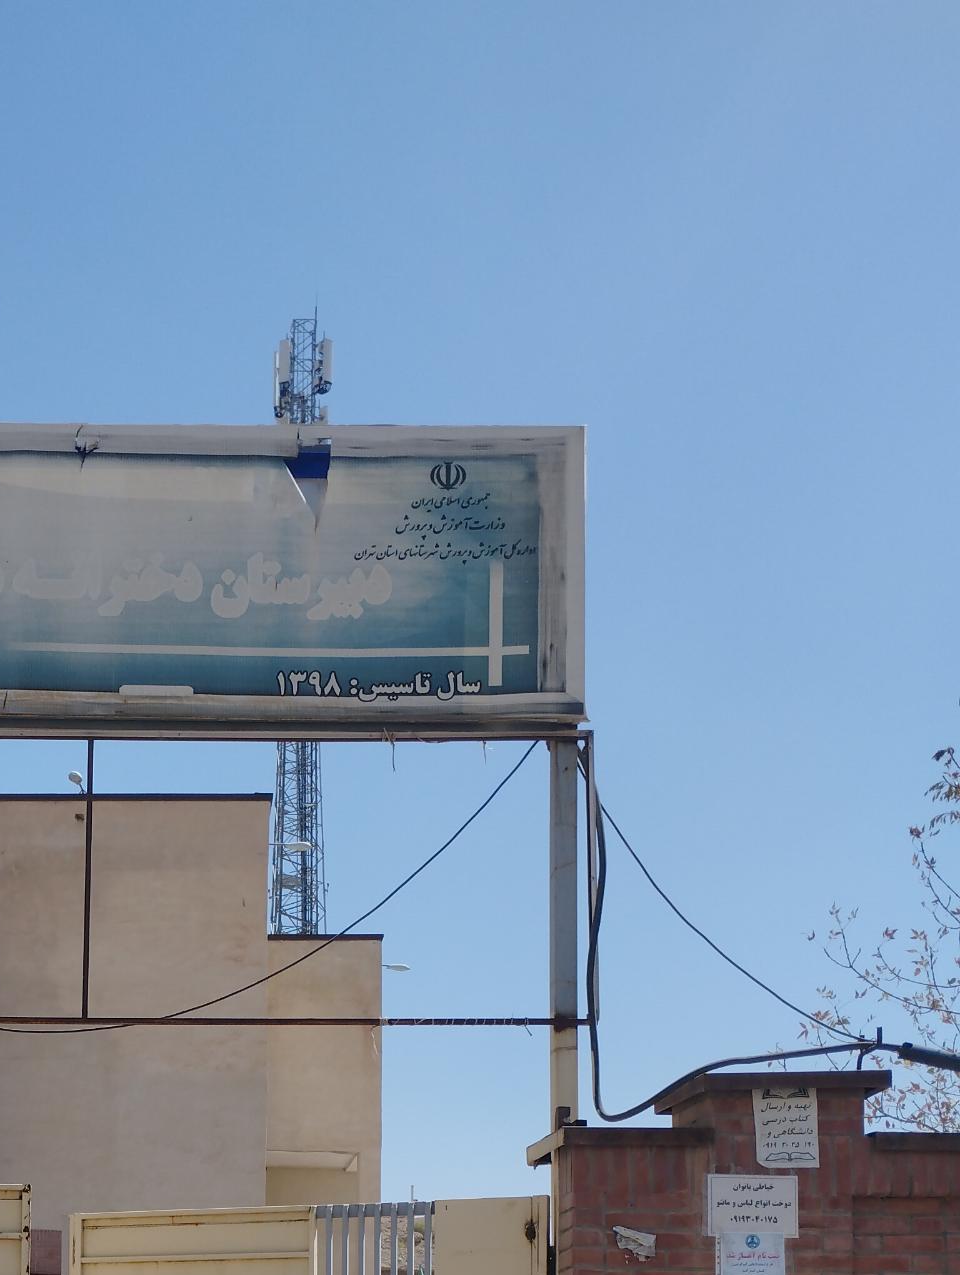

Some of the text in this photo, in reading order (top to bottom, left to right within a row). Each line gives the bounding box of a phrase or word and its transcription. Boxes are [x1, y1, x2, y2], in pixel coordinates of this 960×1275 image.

[411, 493, 491, 512] جمهوری اسلامی ایران
[395, 514, 427, 540] پرورش
[433, 514, 469, 534] آموزش
[469, 517, 506, 531] وزارت
[354, 544, 376, 560] تهران
[375, 544, 398, 560] استان
[440, 542, 468, 565] پرورش
[472, 541, 504, 559] آموزش
[276, 669, 482, 703] سال تاسیس: ۱۳۹۸
[760, 1101, 786, 1113] ارسال
[761, 1114, 811, 1126] کتاب درسی
[732, 1183, 774, 1192] خیاطی بانوان
[737, 1199, 753, 1208] لباس
[754, 1199, 771, 1209] انواع
[772, 1200, 792, 1209] دوخت
